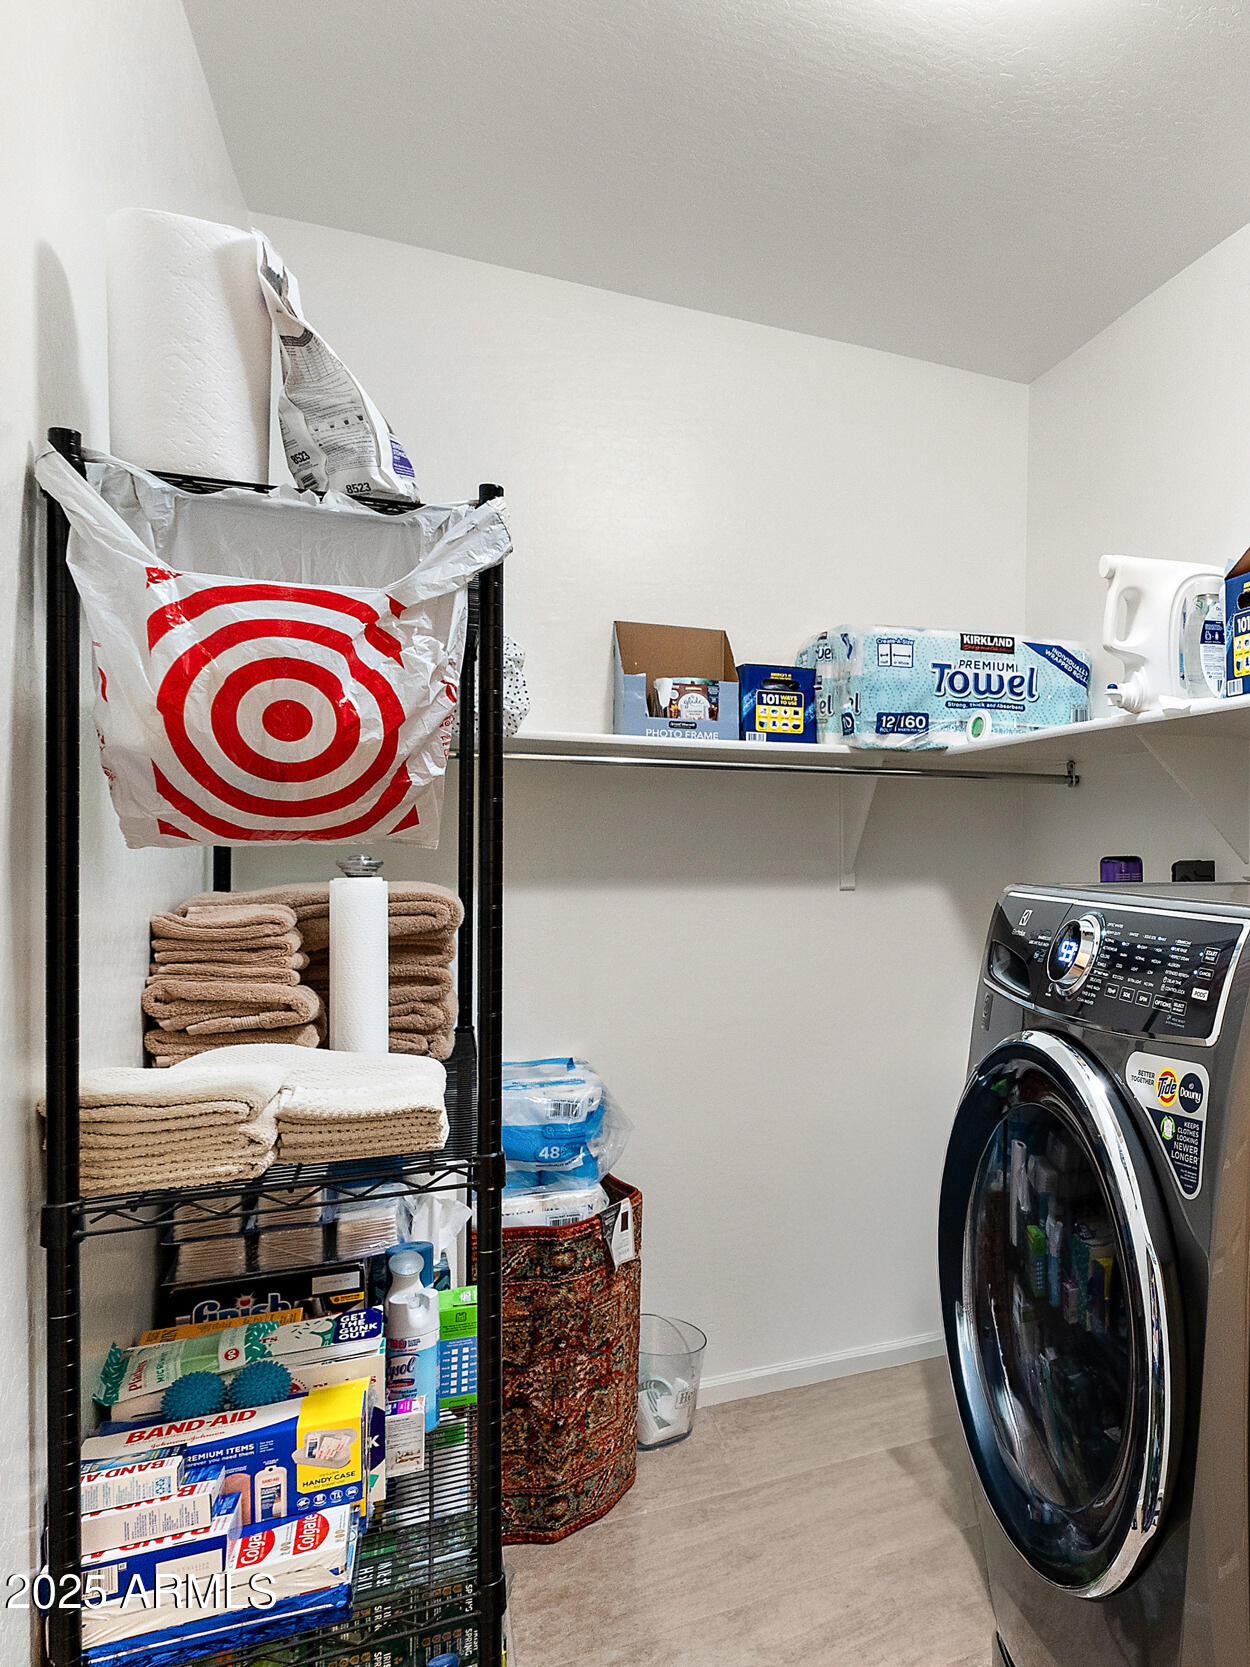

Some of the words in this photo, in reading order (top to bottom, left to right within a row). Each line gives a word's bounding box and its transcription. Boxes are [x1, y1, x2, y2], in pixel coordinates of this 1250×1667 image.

[290, 450, 311, 465] 8523
[345, 482, 372, 494] 8523
[1237, 615, 1250, 634] 101
[963, 634, 1013, 648] KIRKLAND
[959, 660, 1016, 673] PREMIUM
[1045, 649, 1073, 672] WRAPPED
[931, 662, 1037, 699] Towel
[761, 693, 779, 705] 101
[645, 728, 681, 739] PHOTO
[685, 730, 719, 740] FRAME
[1131, 1074, 1155, 1087] TOGETHER
[1137, 1069, 1156, 1079] BETTER
[1157, 1077, 1177, 1097] Tide
[1179, 1086, 1202, 1104] Downy
[1177, 1128, 1200, 1138] CLOTHES
[1184, 1121, 1200, 1131] KEEPS
[1176, 1134, 1199, 1145] LOOKING
[538, 1146, 560, 1159] 48
[1173, 1141, 1199, 1156] NEWER
[1170, 1150, 1199, 1165] LONGER
[339, 1319, 367, 1328] THE
[340, 1312, 367, 1322] GET
[339, 1321, 378, 1334] GUNK
[339, 1330, 367, 1340] OUT
[125, 1410, 257, 1445] BAND-AID
[187, 1449, 224, 1462] REMIUM
[226, 1443, 255, 1456] ITEMS
[80, 1460, 166, 1486] BAND-A
[302, 1476, 332, 1487] HANDY
[334, 1470, 356, 1481] CASE
[296, 1513, 320, 1550] Colgate
[240, 1532, 265, 1564] Colga
